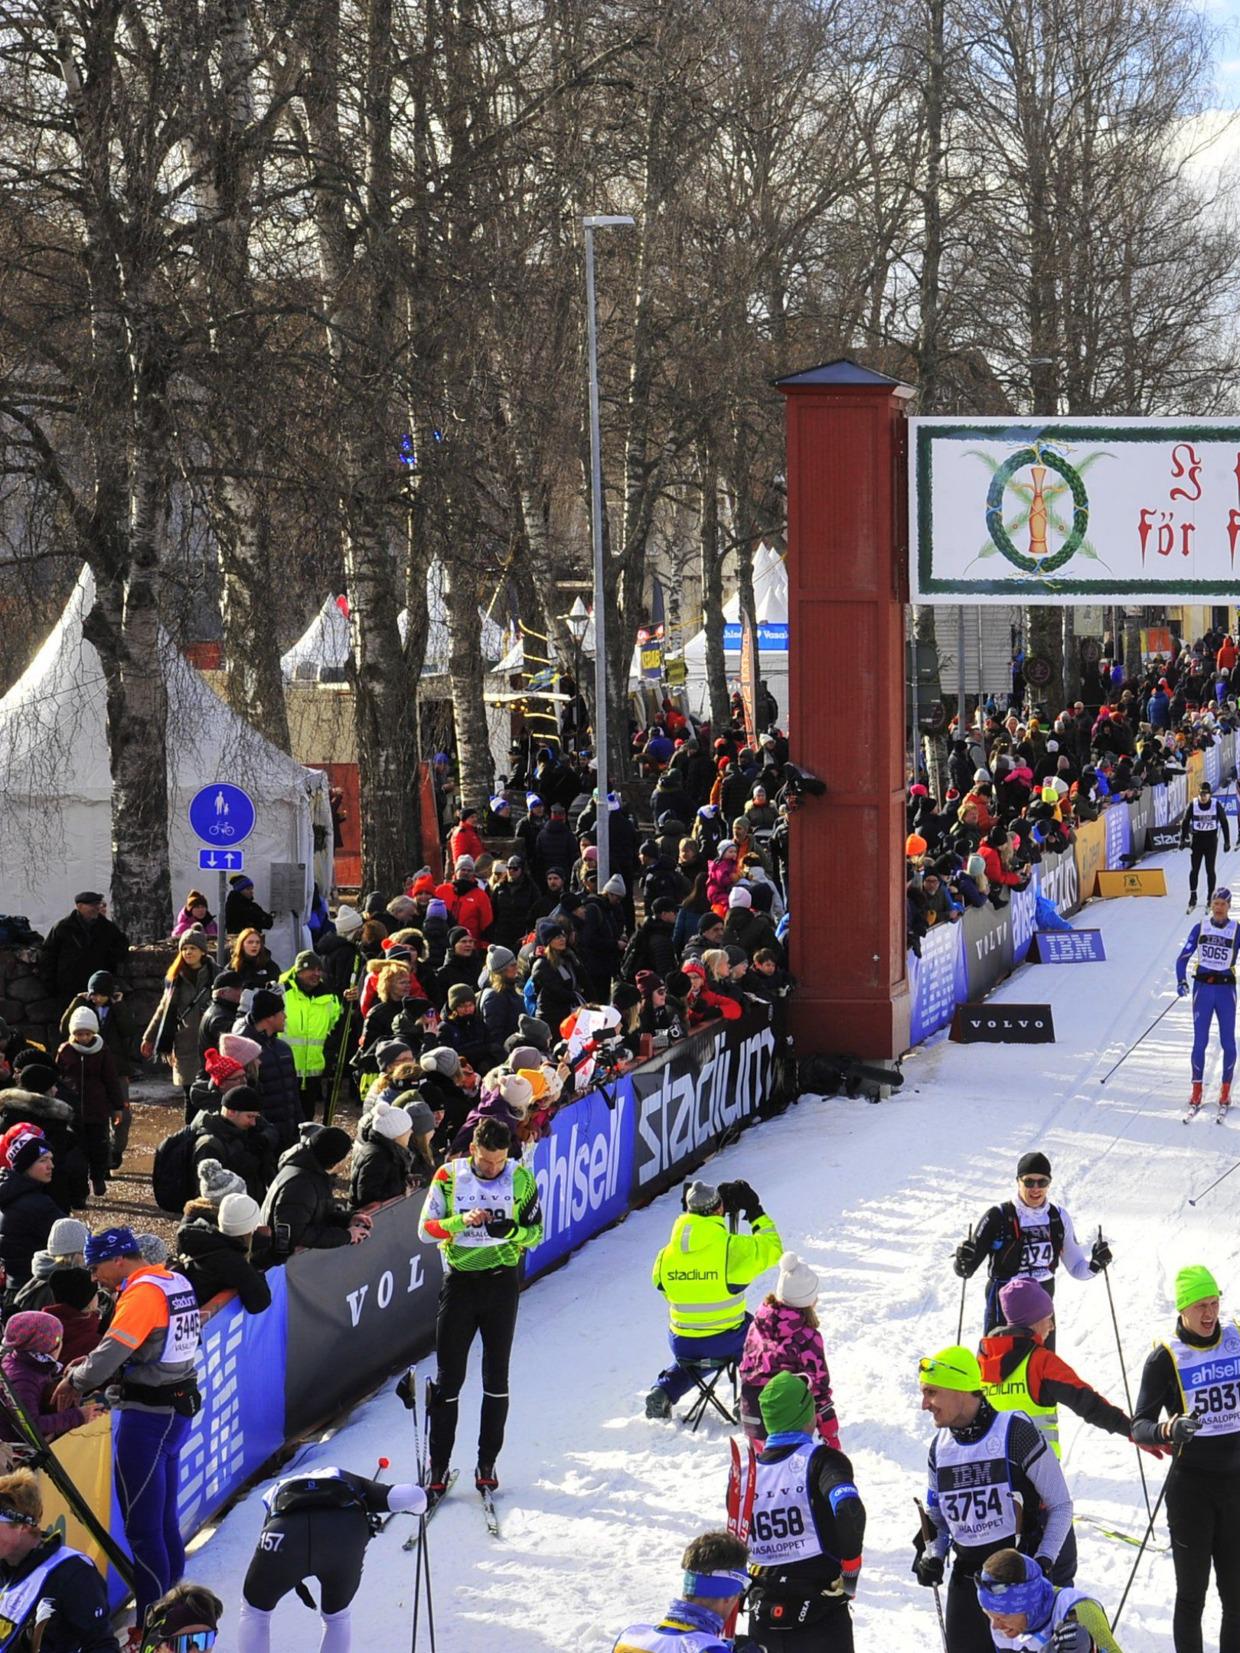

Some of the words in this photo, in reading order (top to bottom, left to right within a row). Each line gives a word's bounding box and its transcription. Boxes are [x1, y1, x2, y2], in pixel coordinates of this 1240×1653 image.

[1045, 934, 1097, 961] IBM
[1201, 944, 1230, 961] 5065
[970, 1019, 1045, 1029] VOLVO
[639, 1026, 775, 1185] stadium
[533, 1096, 626, 1253] ahlsell
[667, 1269, 718, 1281] stadium
[346, 1254, 425, 1328] VOL
[951, 1462, 992, 1488] IBM
[943, 1487, 1003, 1522] 3754
